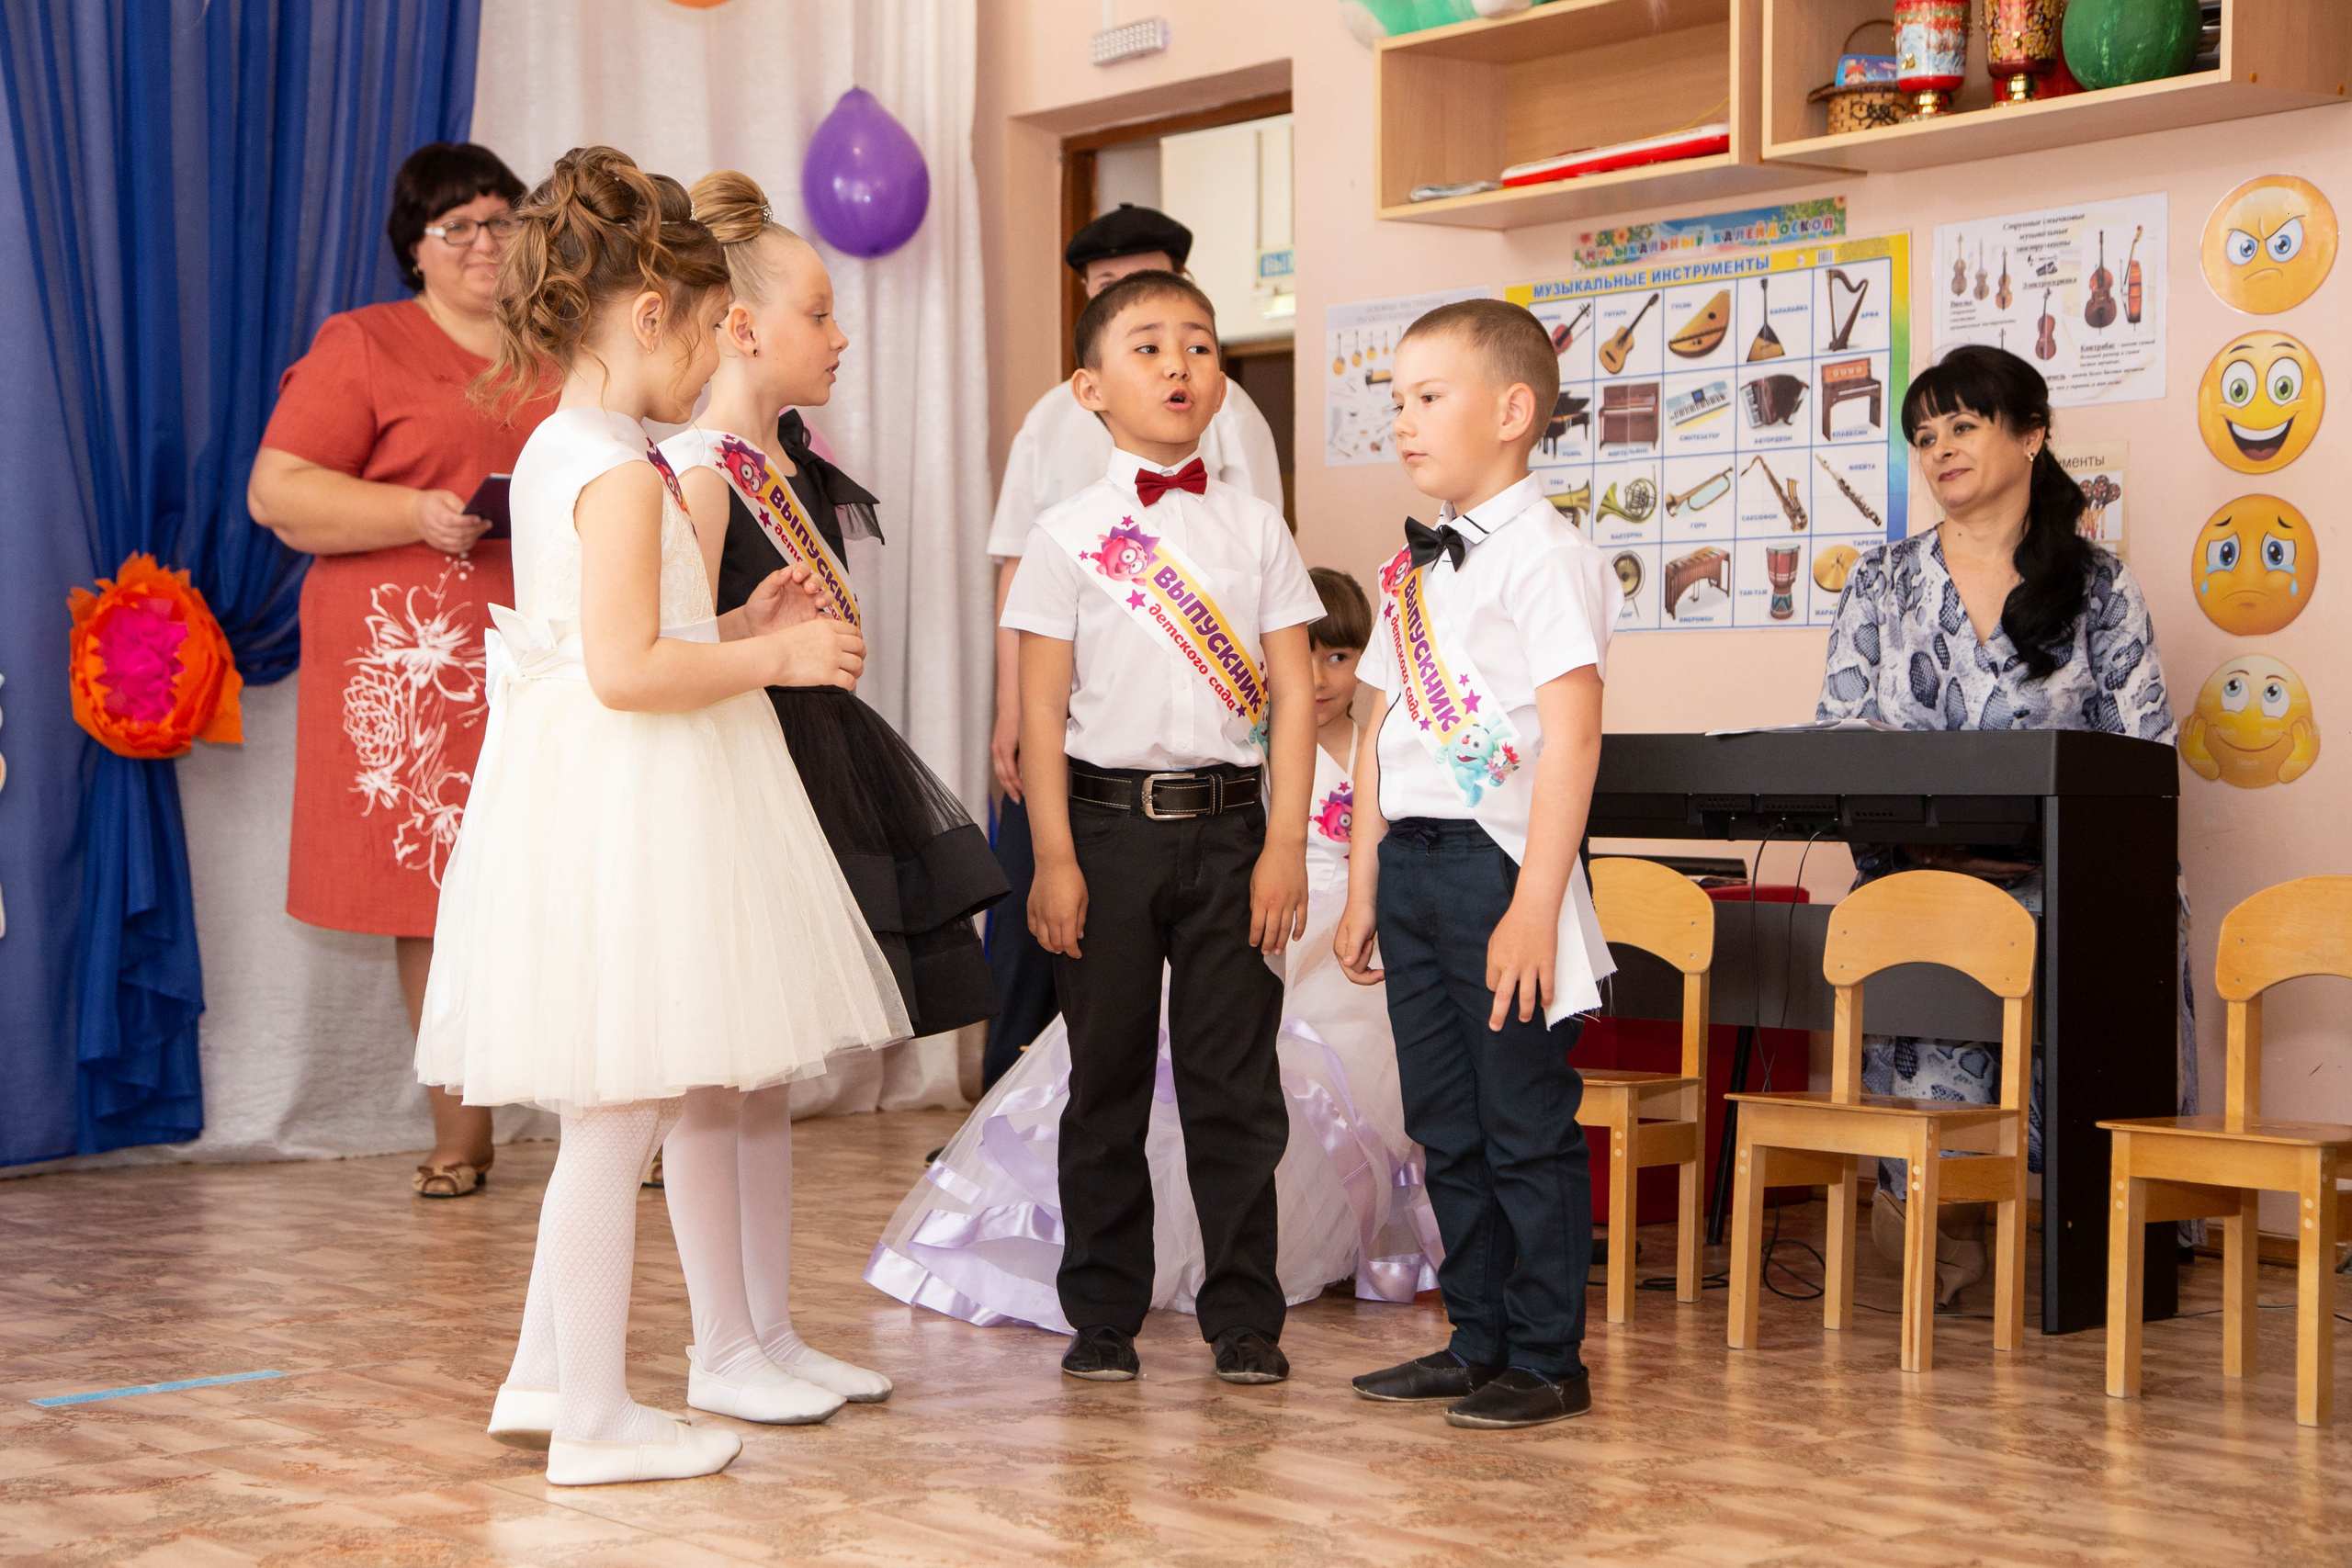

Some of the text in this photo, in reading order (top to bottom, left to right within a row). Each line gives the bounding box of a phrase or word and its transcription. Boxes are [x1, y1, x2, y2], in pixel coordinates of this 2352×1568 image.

[1586, 215, 1834, 261] МУЗЫКАЛЬНЫЙ КАЛЕЙДОСКОП
[1533, 254, 1770, 299] МУЗЫКАЛЬНЫЕ ИНСТРУМЕНТЫ
[1604, 310, 1627, 318] ГИТАРА
[1679, 433, 1720, 442] СИНТЕЗАТОР
[1832, 430, 1868, 438] КЛАВЕСИН
[1849, 463, 1876, 471] ФЛЕЙТА
[1741, 513, 1778, 522] САКСОФОН
[1611, 532, 1644, 540] ВАЛТОРНА
[1853, 539, 1883, 547] ТАРЕЛКИ
[769, 485, 858, 626] ВЫПУСКНИ
[1153, 565, 1262, 715] ВЫПУСКНИК
[1404, 574, 1462, 733] ВЫПУСКНИК
[1148, 604, 1237, 711] детского сада
[1391, 614, 1419, 722] детского сада
